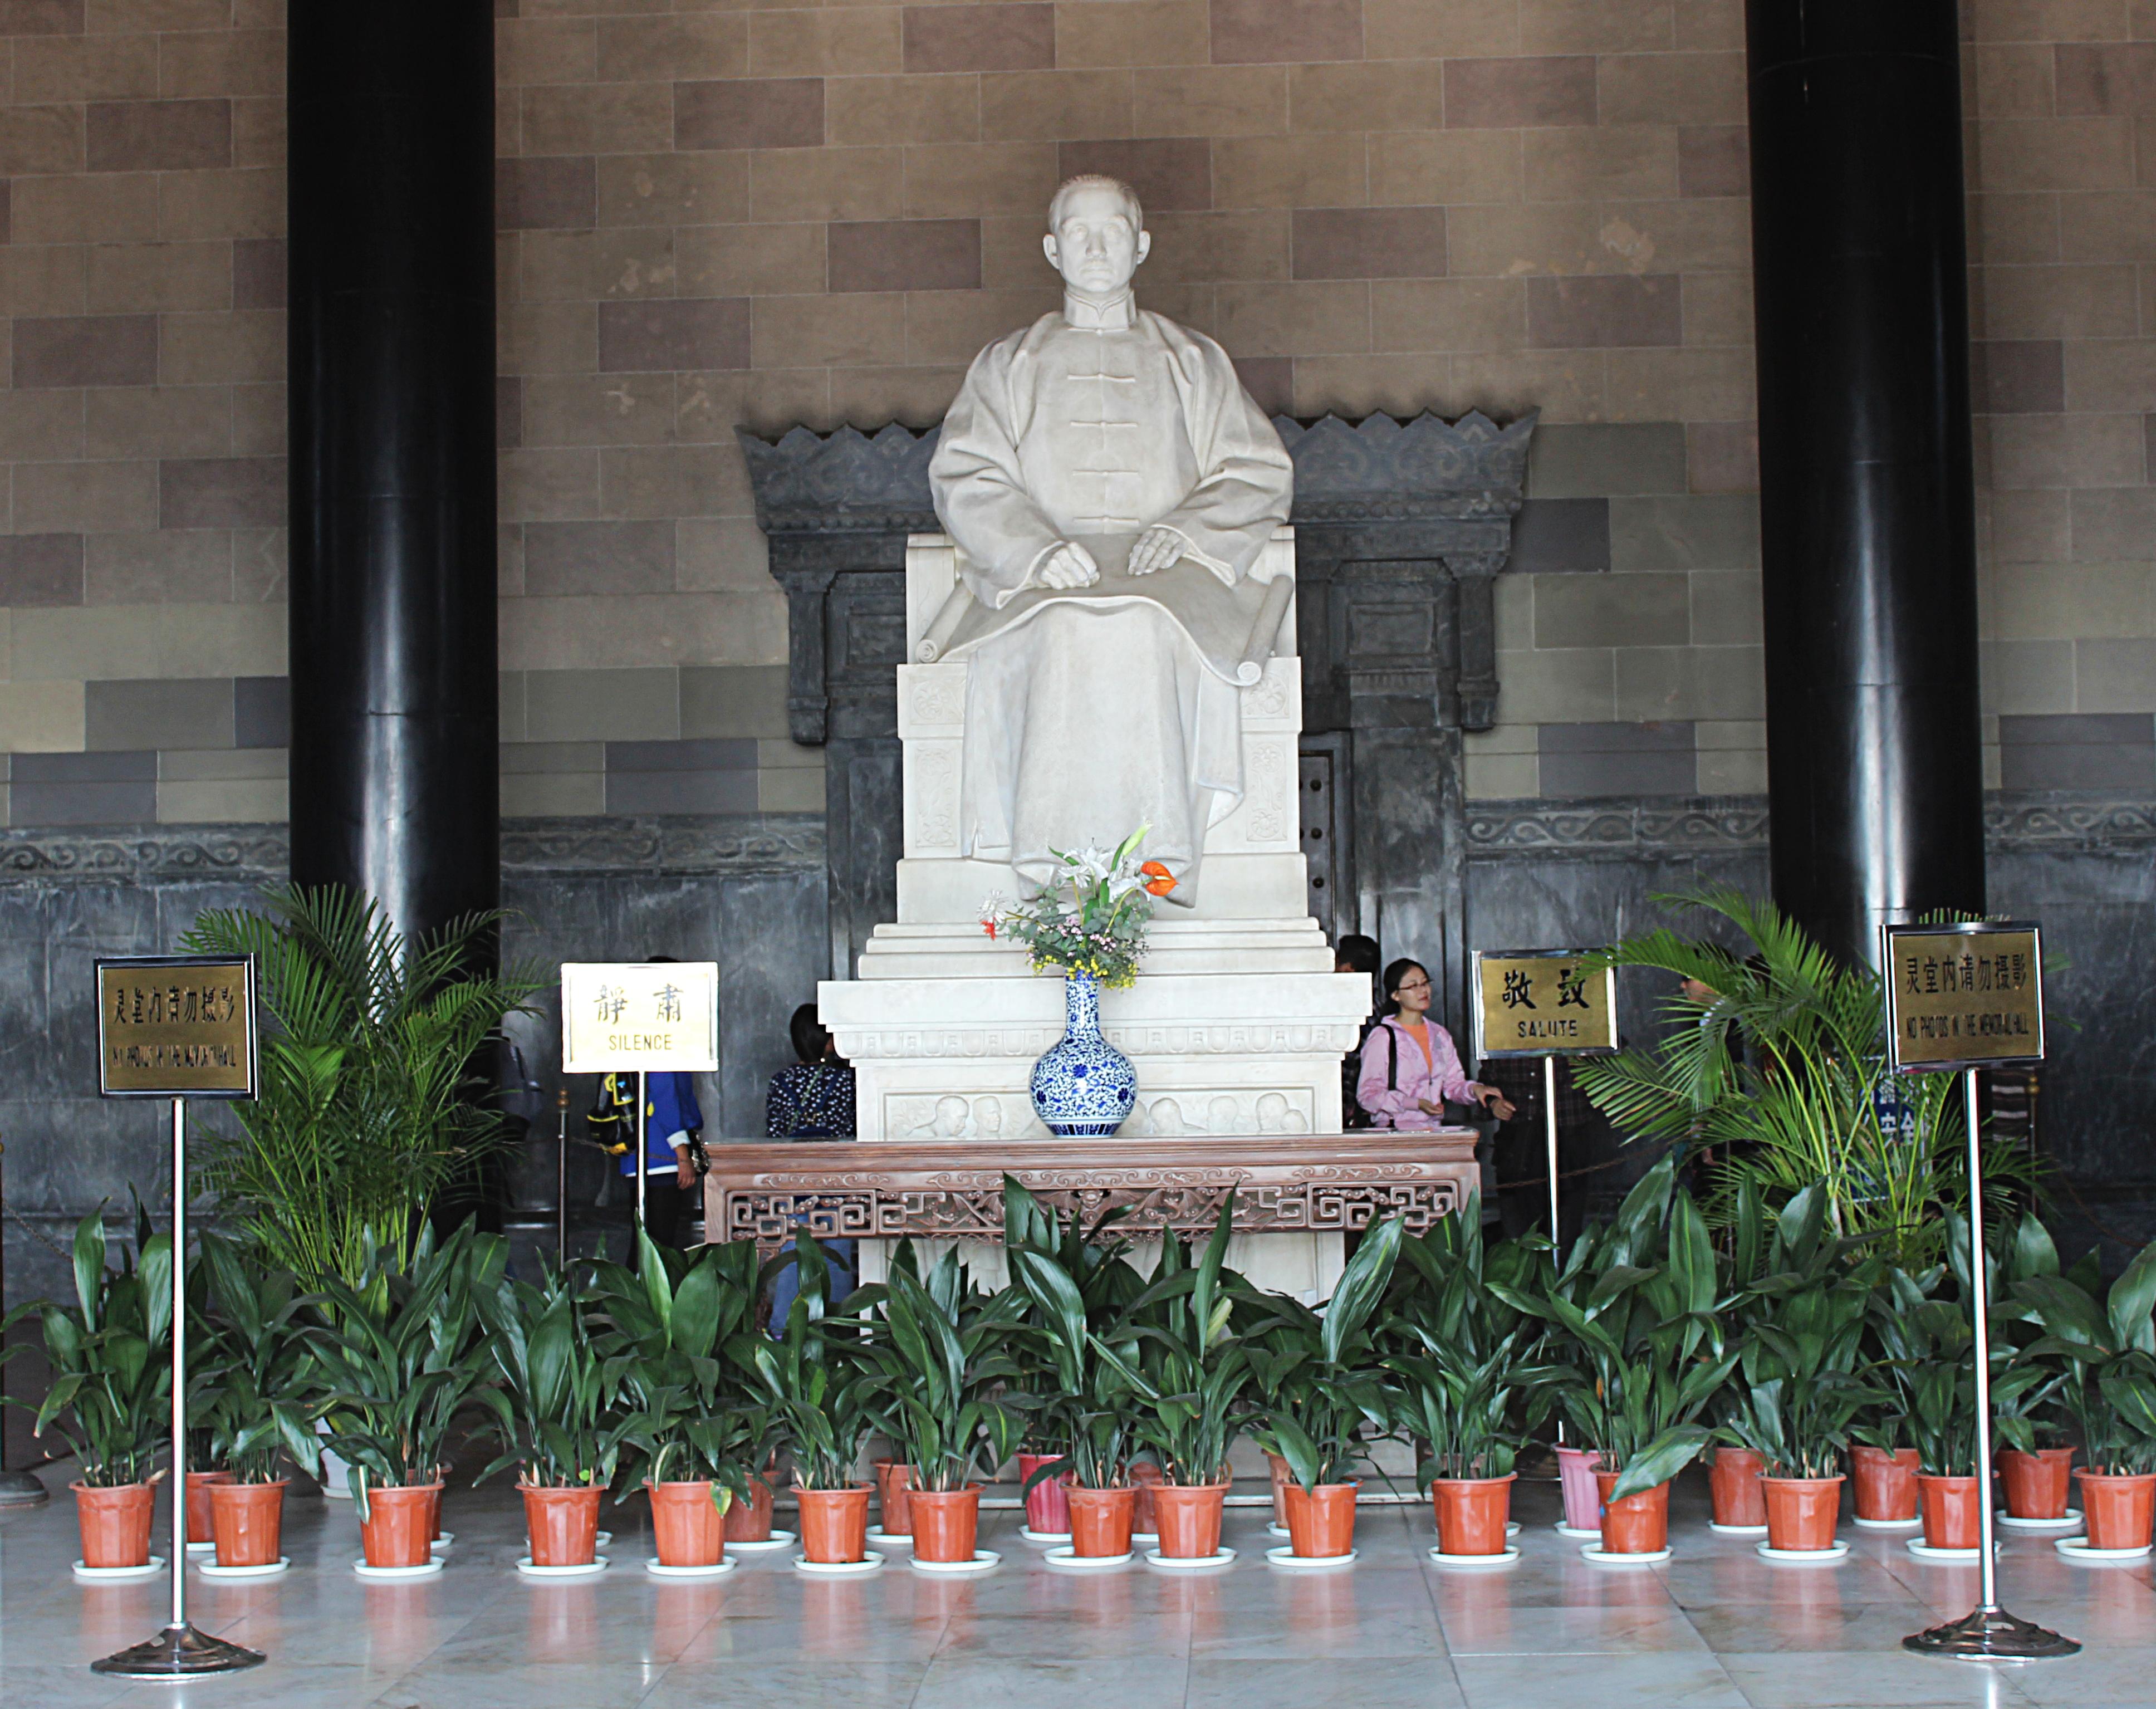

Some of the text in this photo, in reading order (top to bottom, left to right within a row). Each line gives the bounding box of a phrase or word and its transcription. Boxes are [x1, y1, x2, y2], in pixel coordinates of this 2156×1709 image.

[1906, 954, 2026, 995] 灵堂内请勿摄影
[114, 985, 234, 1024] 灵堂内请勿摄影
[609, 1034, 672, 1051] SILENCE
[1518, 1019, 1578, 1038] SALUTE
